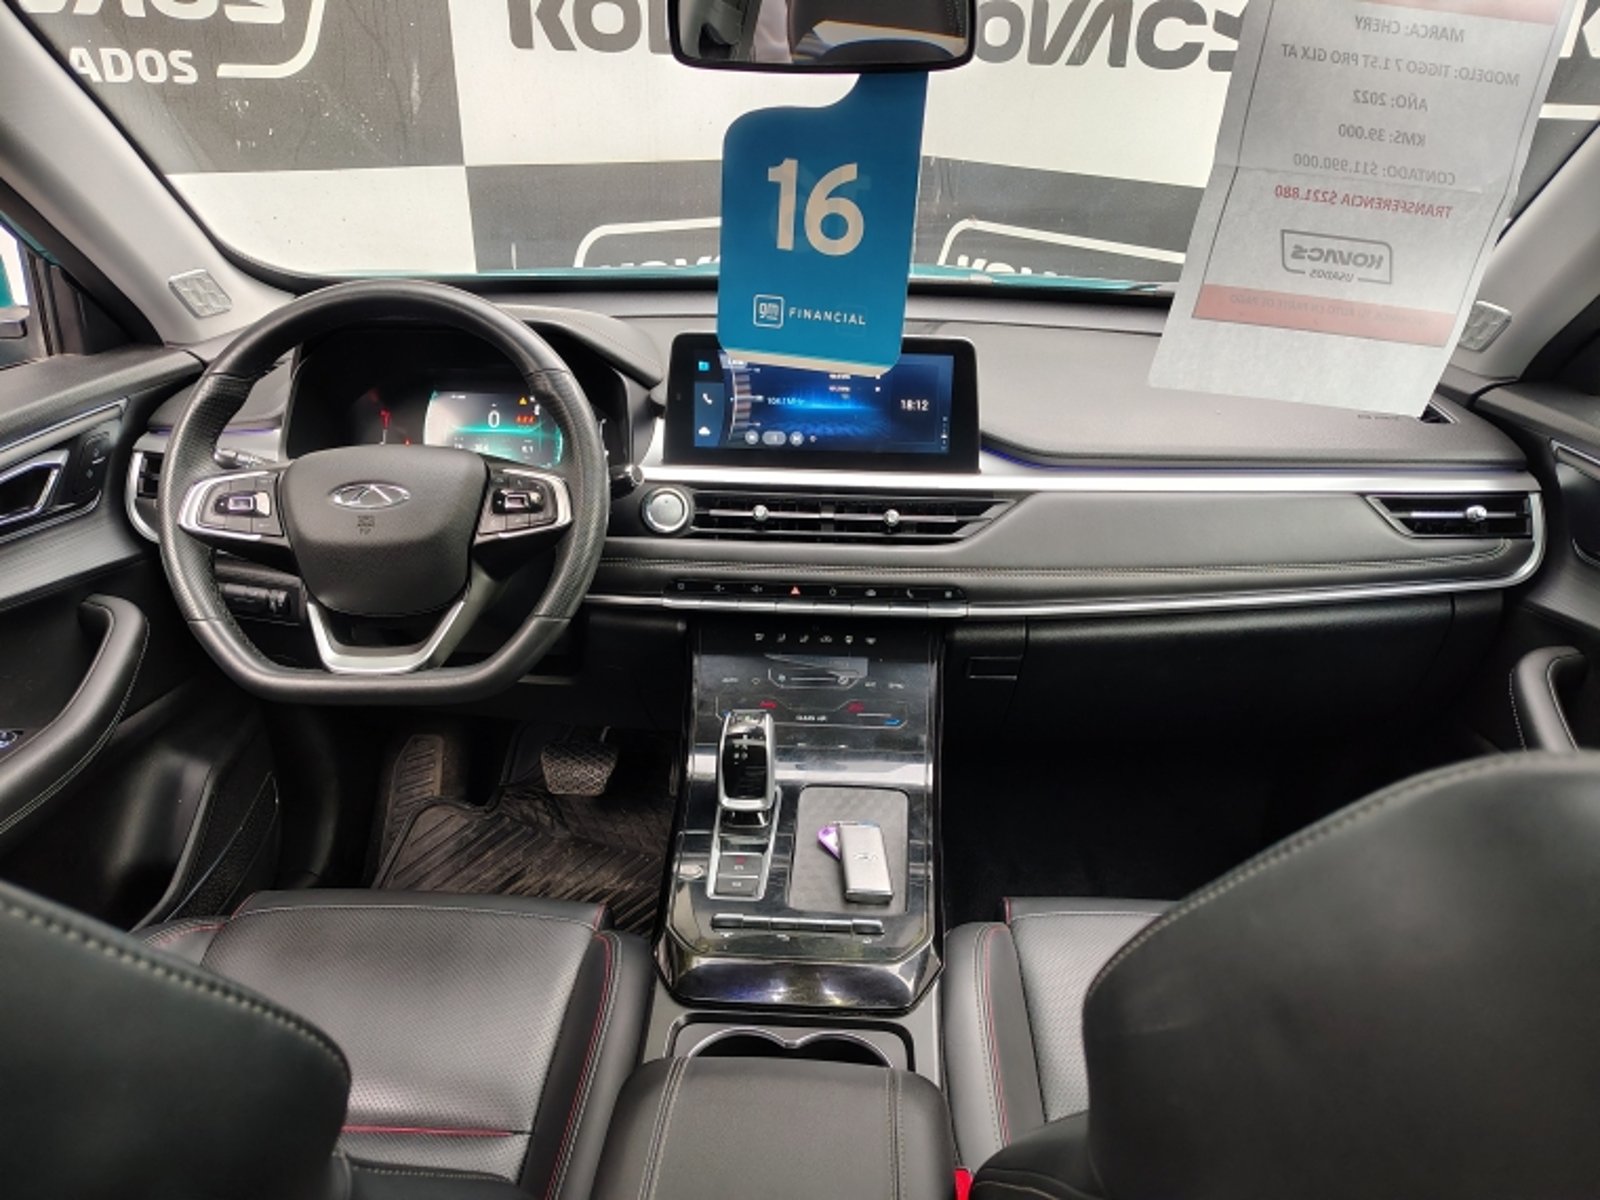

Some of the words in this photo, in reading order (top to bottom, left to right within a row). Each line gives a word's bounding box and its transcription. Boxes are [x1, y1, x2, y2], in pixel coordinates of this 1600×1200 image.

[68, 46, 199, 84] ADOS
[767, 158, 865, 257] 16
[788, 306, 866, 326] FINANCIAL
